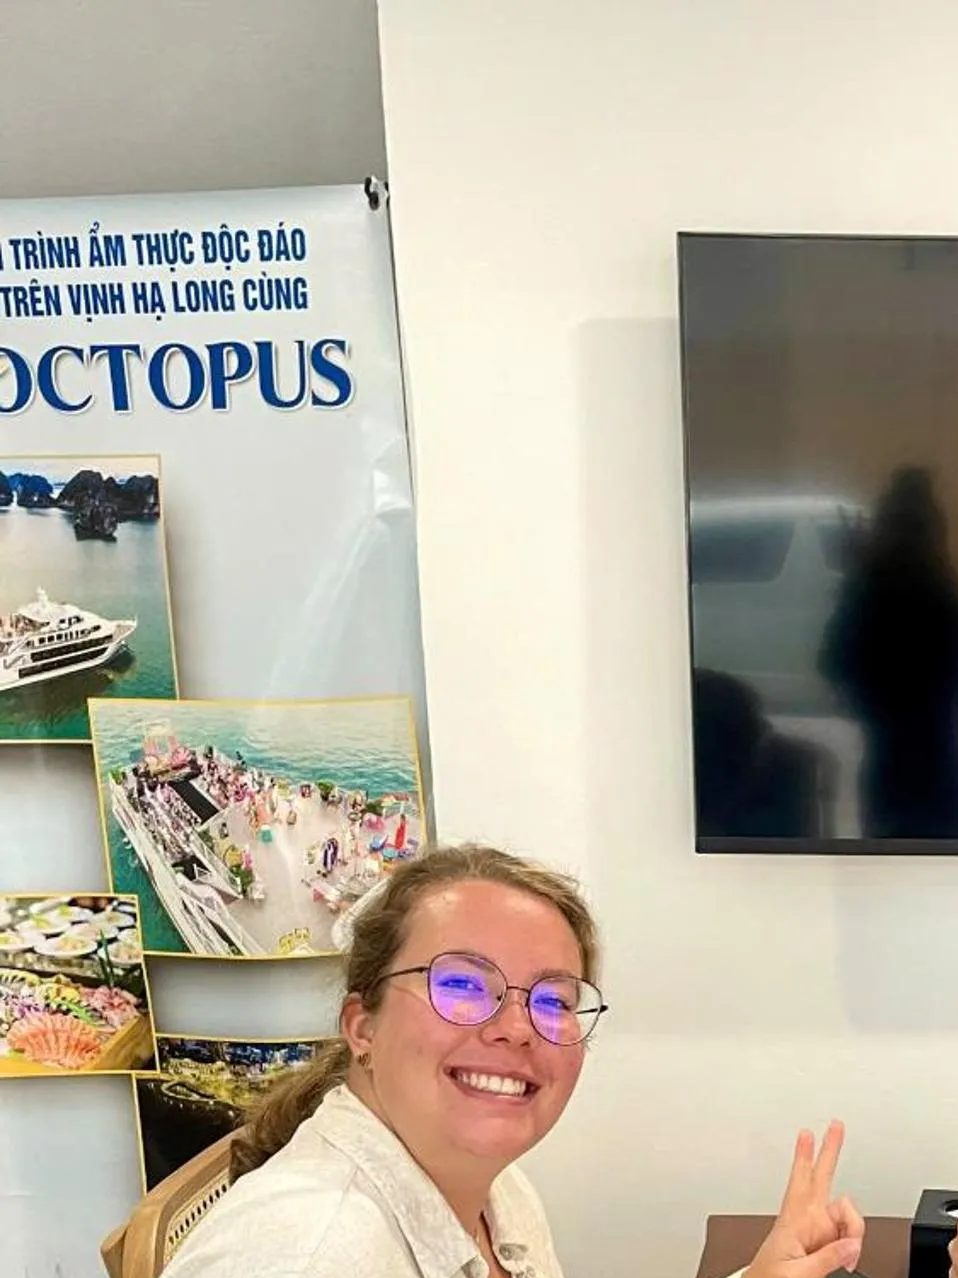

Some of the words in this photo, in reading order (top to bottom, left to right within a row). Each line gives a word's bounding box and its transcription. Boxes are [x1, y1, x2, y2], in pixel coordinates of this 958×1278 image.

[9, 230, 80, 270] TRÌNH
[88, 221, 126, 267] ẨM
[132, 229, 194, 272] THỰC
[202, 223, 250, 270] ĐỘC
[257, 221, 306, 262] ĐÁO
[0, 278, 61, 317] TRÊN
[67, 282, 125, 322] VỊNH
[132, 282, 166, 321] HẠ
[171, 279, 235, 313] LONG
[242, 271, 308, 311] CÙNG
